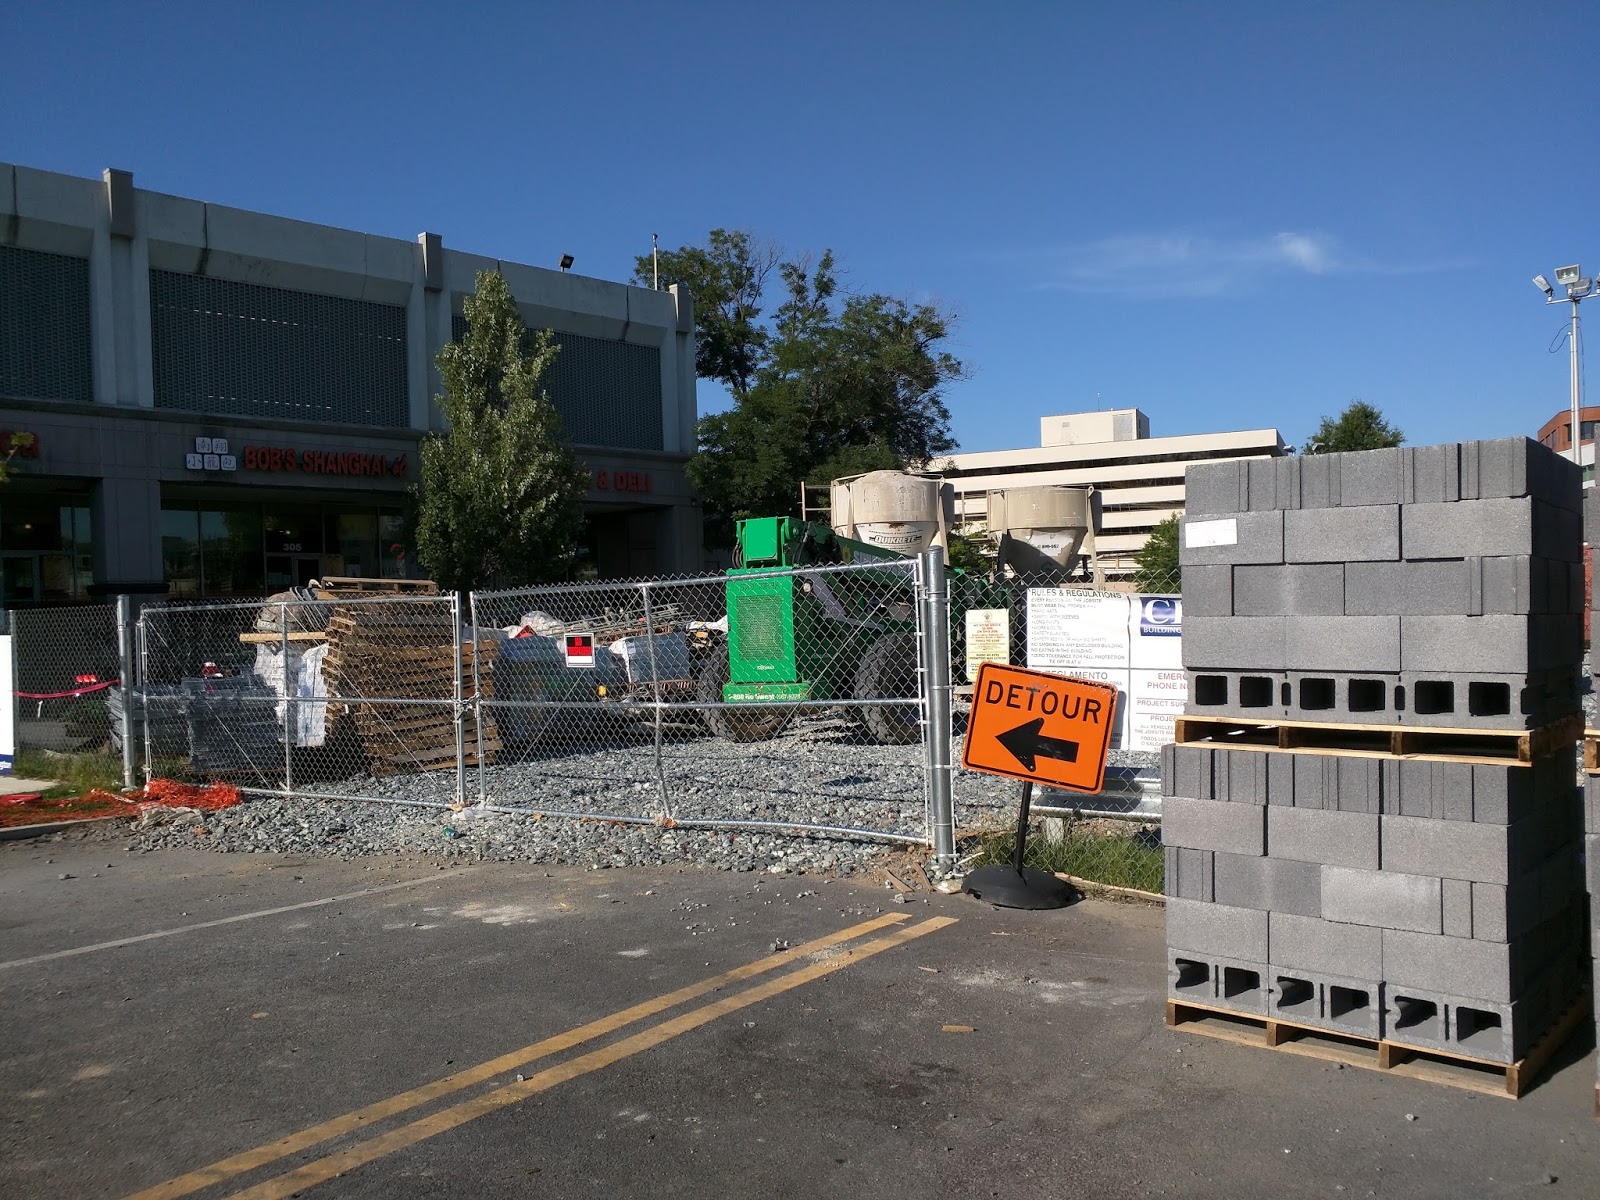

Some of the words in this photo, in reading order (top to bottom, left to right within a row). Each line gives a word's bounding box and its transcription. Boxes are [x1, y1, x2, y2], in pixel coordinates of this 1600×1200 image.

[244, 446, 297, 472] BOB'S
[302, 450, 388, 476] SHANGHAI
[614, 470, 653, 492] DELI
[875, 535, 917, 544] QUIKRETE
[283, 543, 303, 553] 305
[1031, 588, 1057, 597] RULES
[1058, 589, 1065, 597] &
[1065, 589, 1122, 599] REGULATIONS
[1045, 670, 1108, 680] GLAMENTO
[1157, 672, 1187, 681] EMER
[1147, 681, 1178, 690] PHONE
[984, 680, 1102, 725] DETOUR
[1137, 699, 1169, 707] PROJECT
